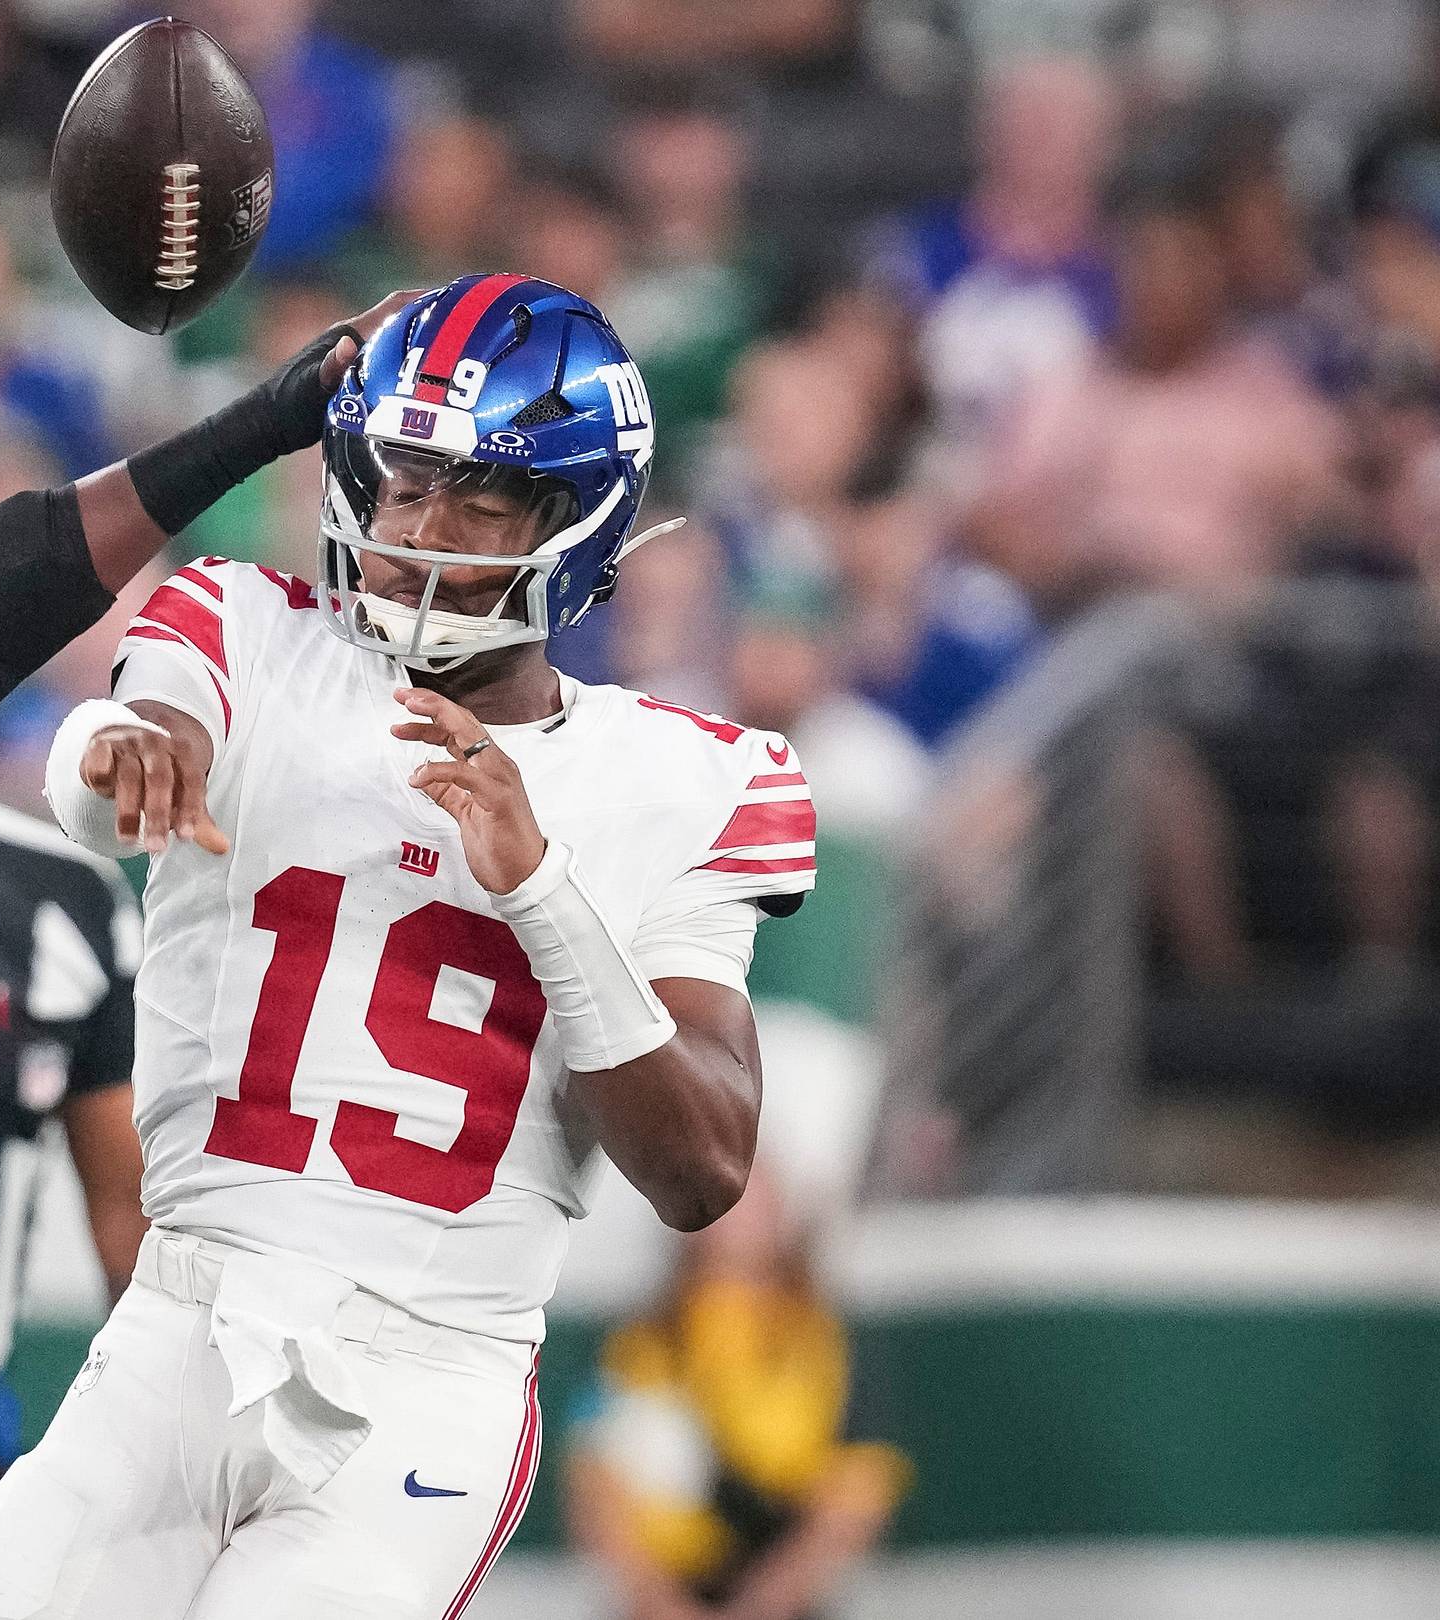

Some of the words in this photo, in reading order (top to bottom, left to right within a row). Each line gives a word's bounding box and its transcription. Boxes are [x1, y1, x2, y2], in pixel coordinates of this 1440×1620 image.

[394, 347, 489, 410] 19
[480, 442, 531, 457] OAKLEY
[203, 866, 547, 1214] 19
